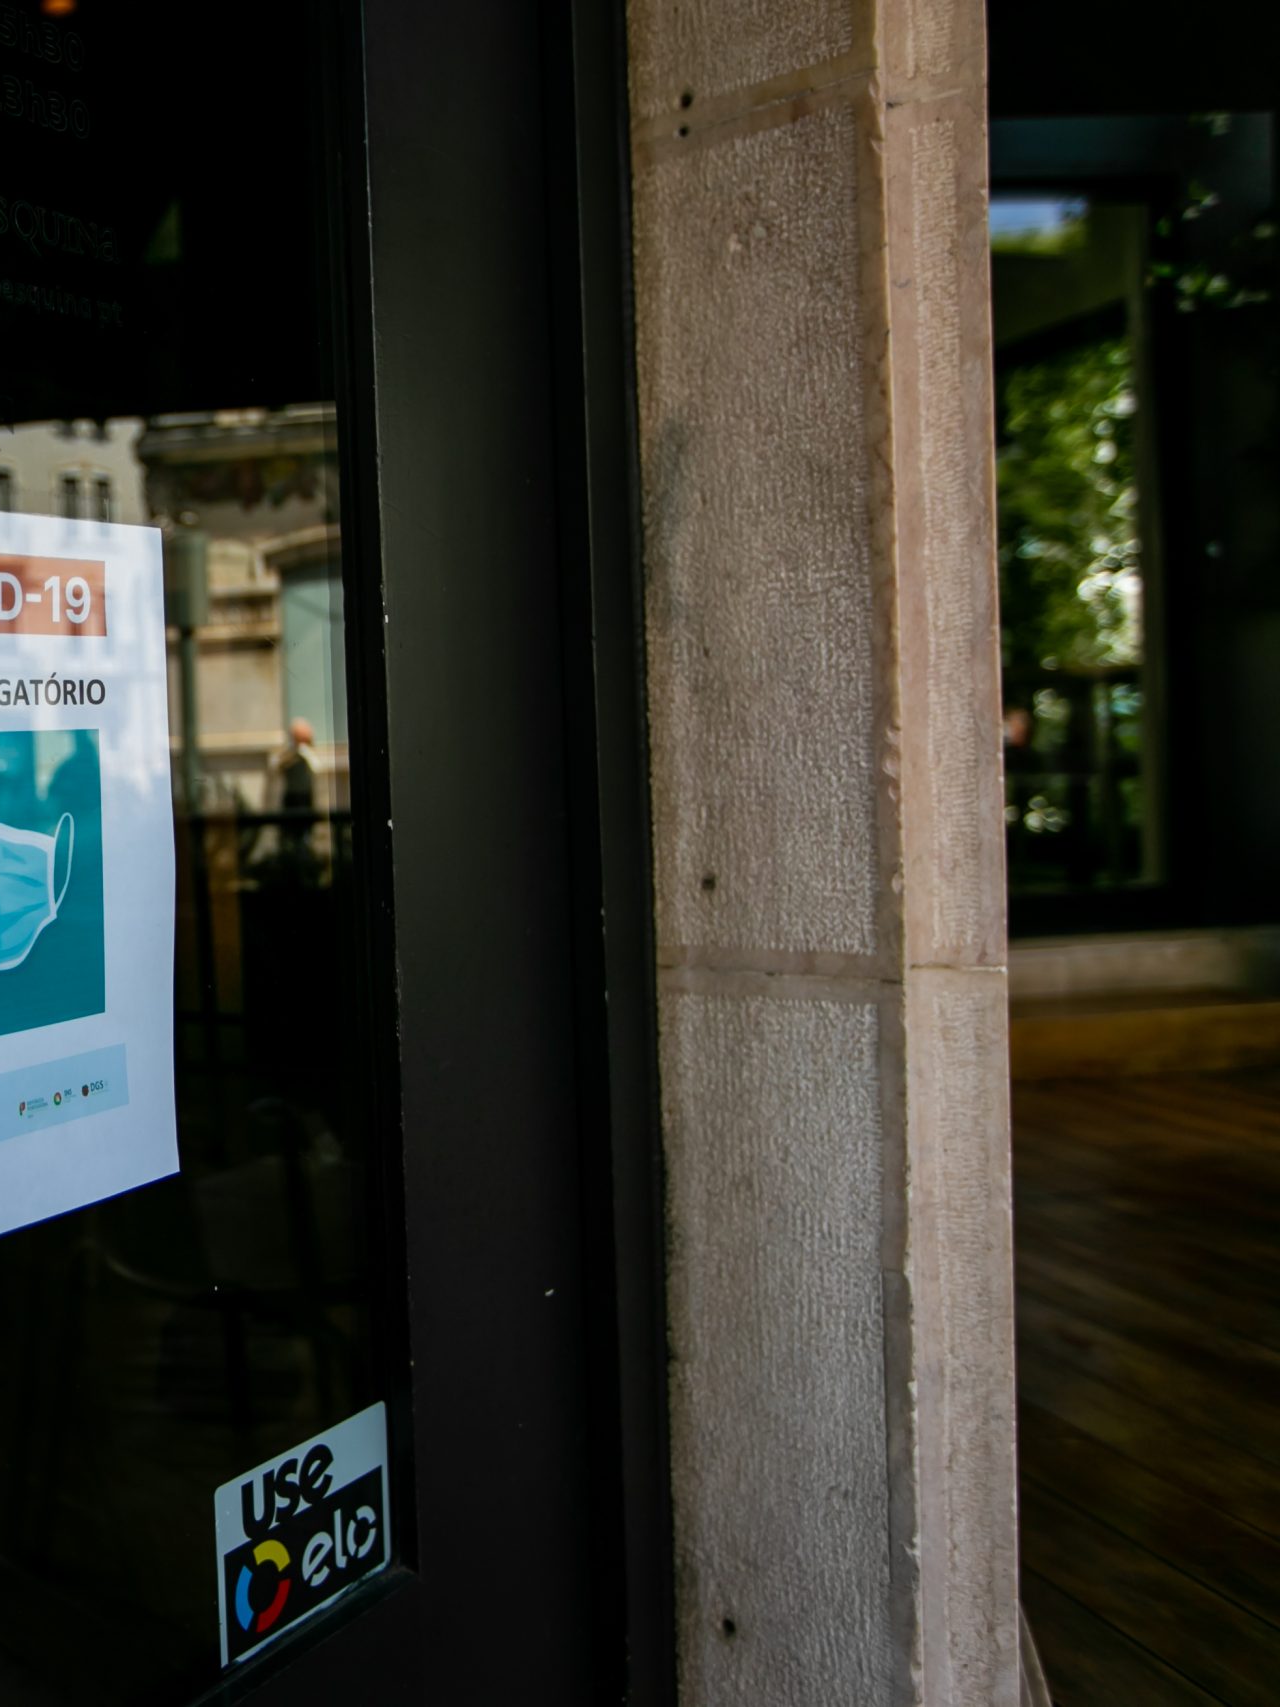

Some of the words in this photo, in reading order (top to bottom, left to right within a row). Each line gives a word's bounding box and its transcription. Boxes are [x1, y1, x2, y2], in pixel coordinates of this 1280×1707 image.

[90, 1080, 104, 1092] DGS
[240, 1443, 334, 1540] use
[301, 1505, 377, 1588] elo
